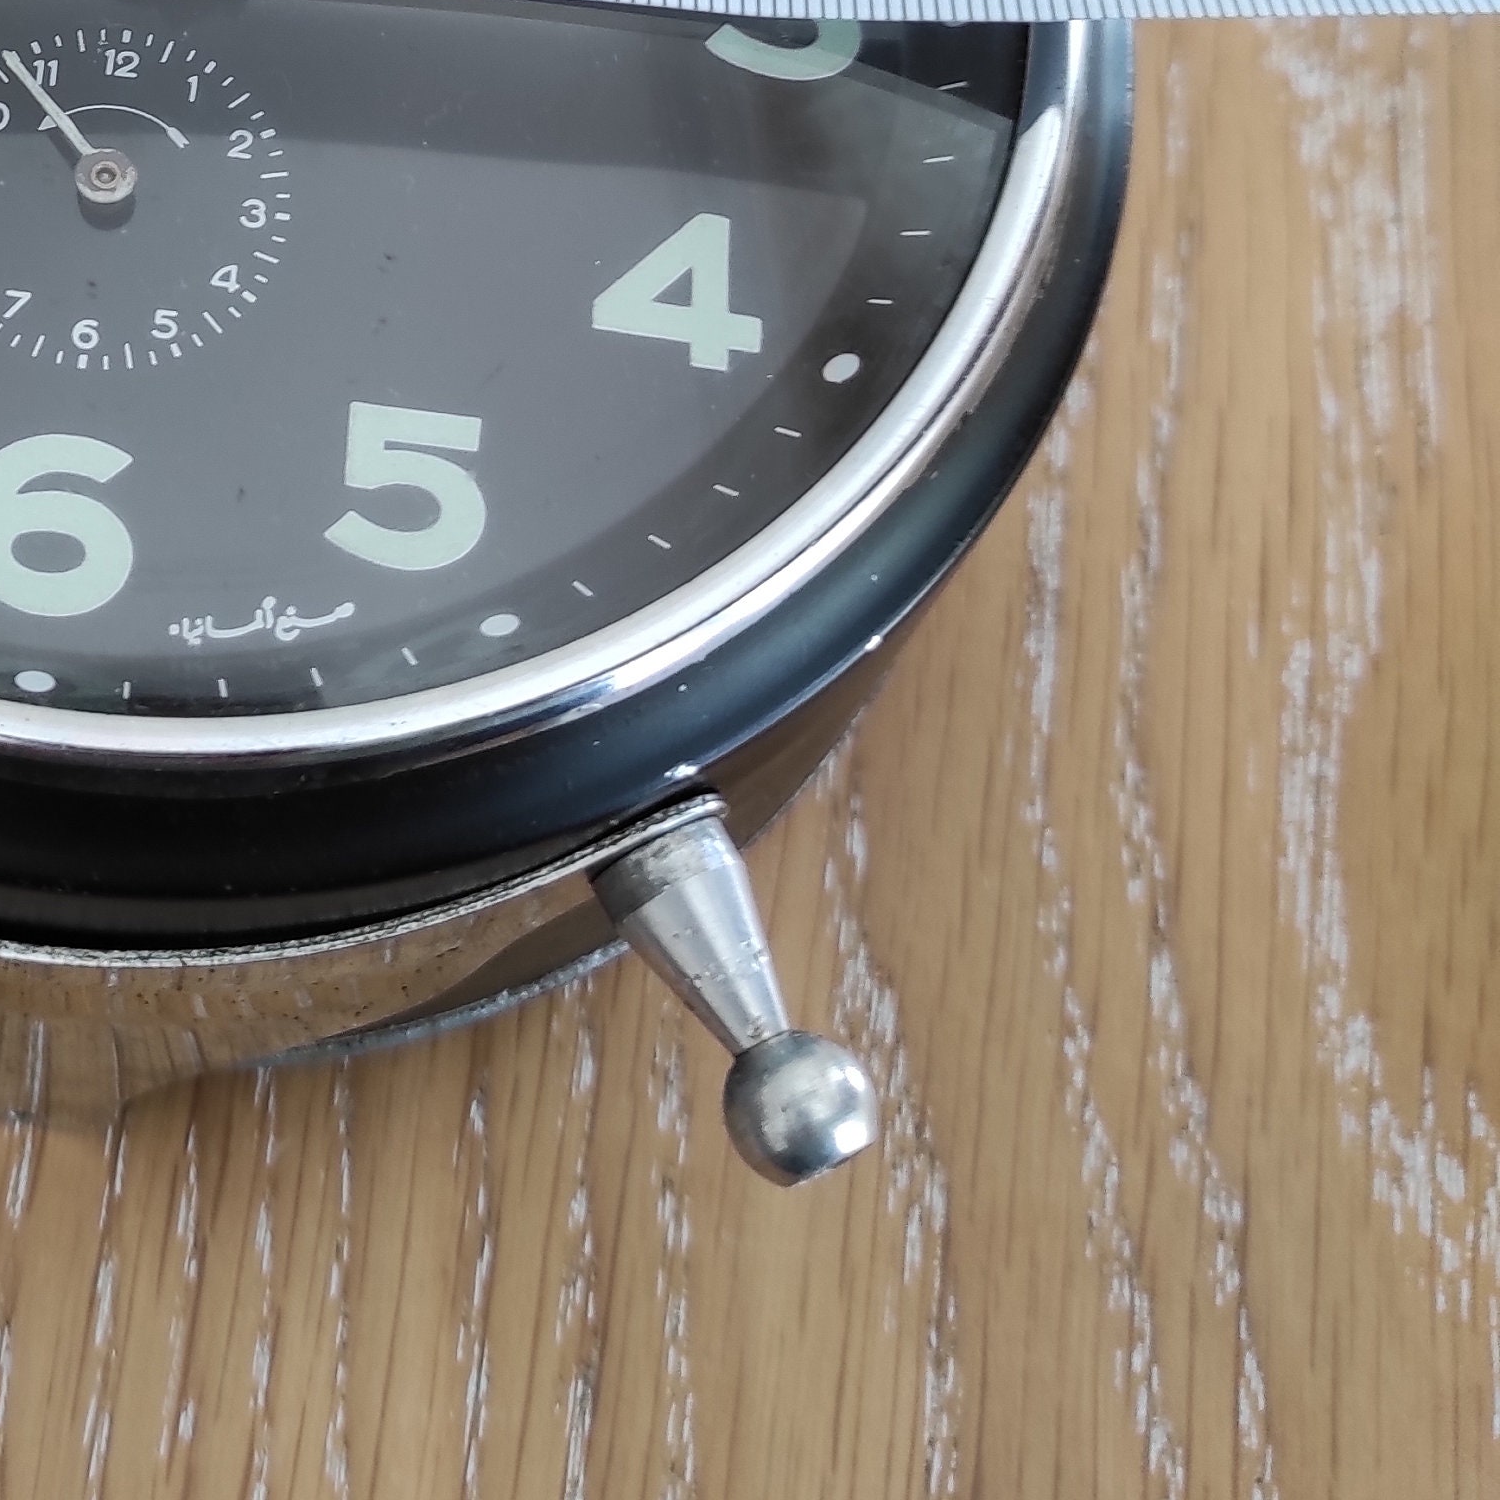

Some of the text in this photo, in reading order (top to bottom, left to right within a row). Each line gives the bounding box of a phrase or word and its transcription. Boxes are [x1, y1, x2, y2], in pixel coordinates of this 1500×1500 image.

[33, 60, 58, 86] 11
[105, 49, 141, 78] 12
[187, 76, 199, 102] 1
[227, 130, 254, 159] 2
[240, 199, 267, 229] 3
[210, 265, 240, 293] 4
[592, 212, 763, 371] 4
[3, 290, 32, 319] 7
[71, 320, 100, 350] 6
[151, 310, 179, 339] 5
[324, 401, 487, 572] 5
